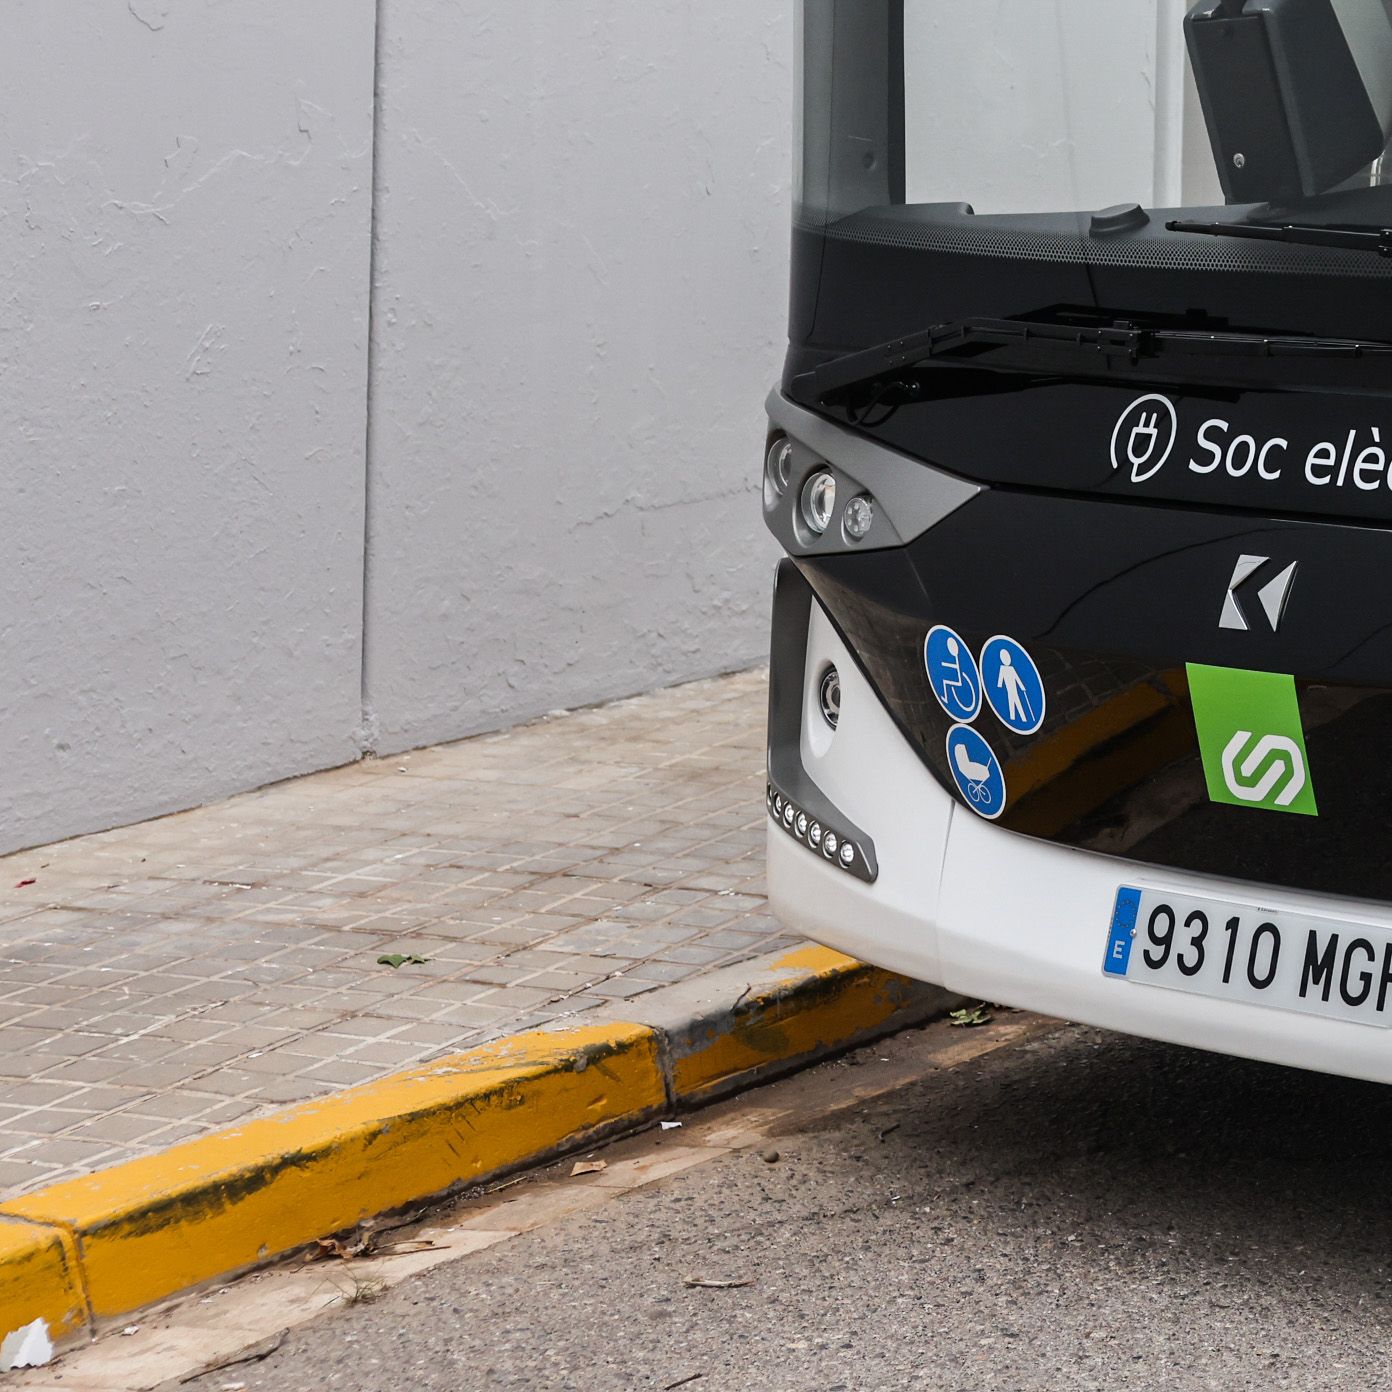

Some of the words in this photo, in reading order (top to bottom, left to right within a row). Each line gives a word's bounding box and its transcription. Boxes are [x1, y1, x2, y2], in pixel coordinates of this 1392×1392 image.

[1188, 418, 1289, 481] Soc
[1112, 939, 1124, 960] E
[1142, 903, 1282, 991] 9310
